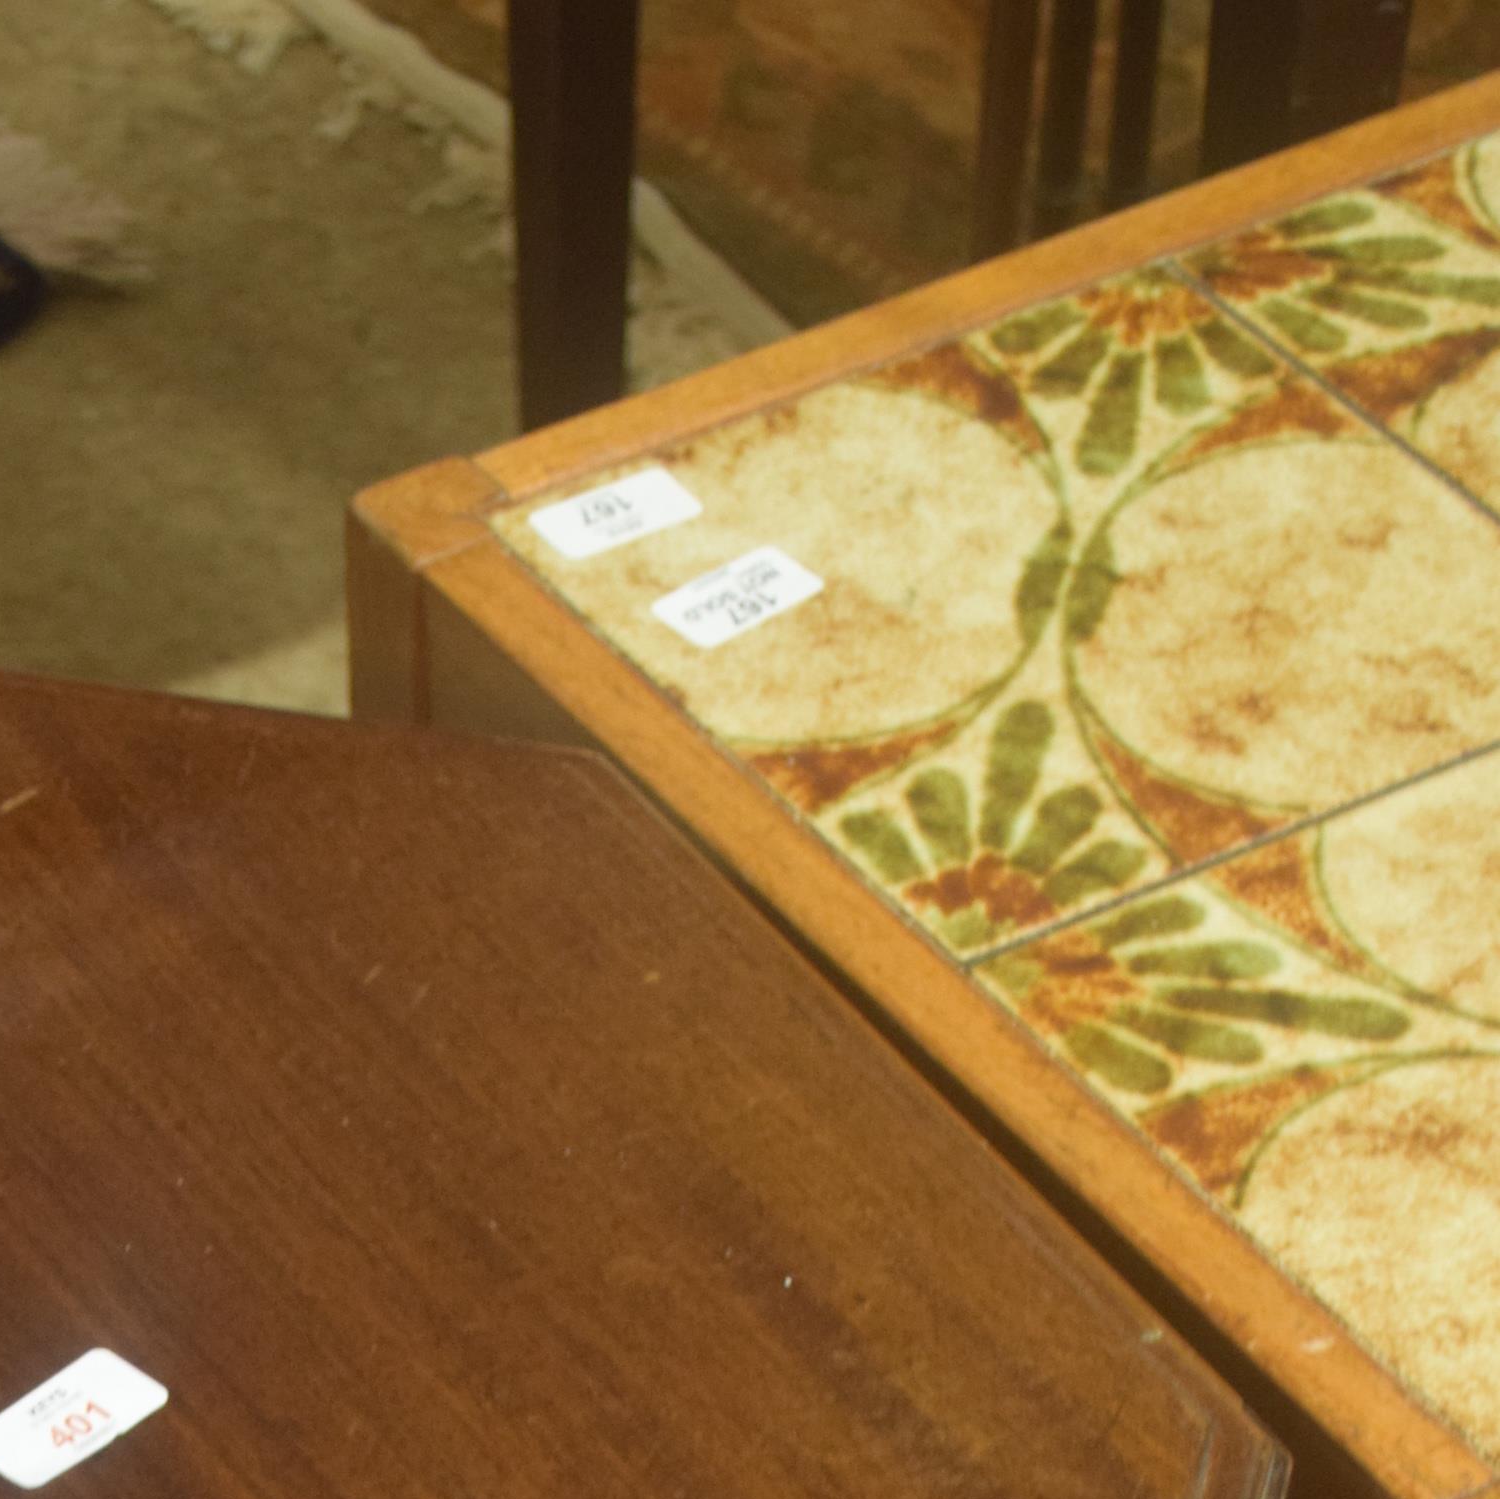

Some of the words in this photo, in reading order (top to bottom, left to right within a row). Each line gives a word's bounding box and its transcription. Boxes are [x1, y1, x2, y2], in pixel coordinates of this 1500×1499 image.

[579, 493, 632, 526] 167
[726, 592, 778, 627] 167
[51, 1400, 112, 1448] 401
